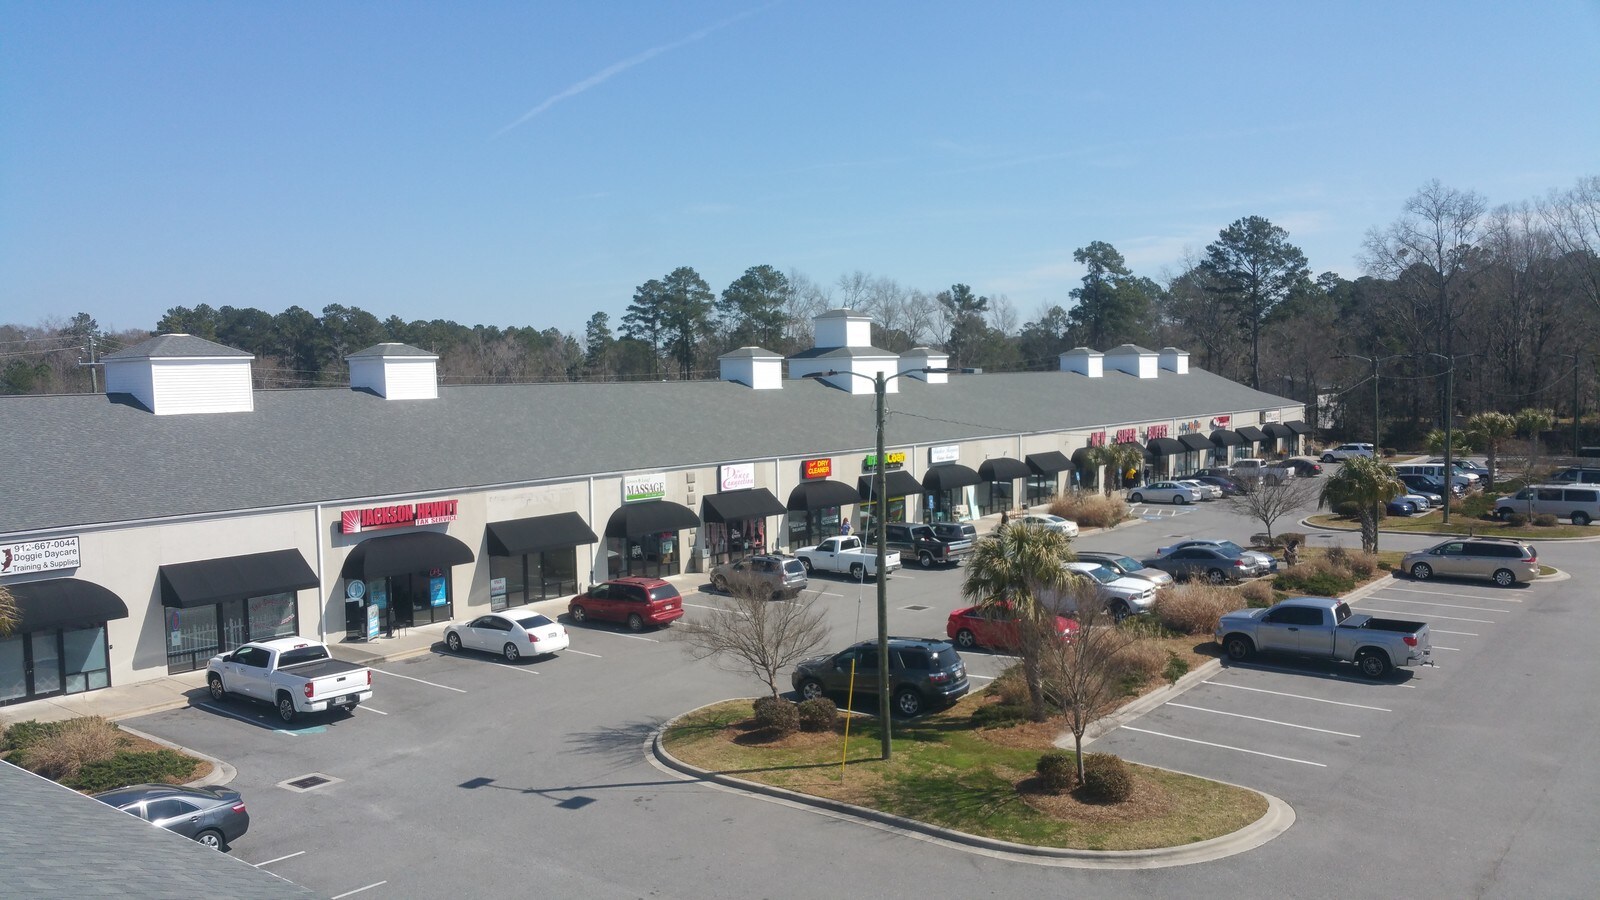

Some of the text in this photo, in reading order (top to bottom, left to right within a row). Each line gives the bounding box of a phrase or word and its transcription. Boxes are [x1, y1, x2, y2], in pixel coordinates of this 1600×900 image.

[1091, 431, 1106, 447] NEW
[1117, 428, 1136, 444] SUPER
[1147, 424, 1168, 440] BUFFET
[626, 482, 665, 495] MASSAGE
[361, 500, 458, 526] JACKSON HEWITT
[431, 515, 458, 523] SERVICE
[14, 540, 76, 552] 912-667-0044
[13, 548, 77, 562] Doggie Daycare
[13, 564, 42, 572] Training
[50, 558, 79, 568] Supplies
